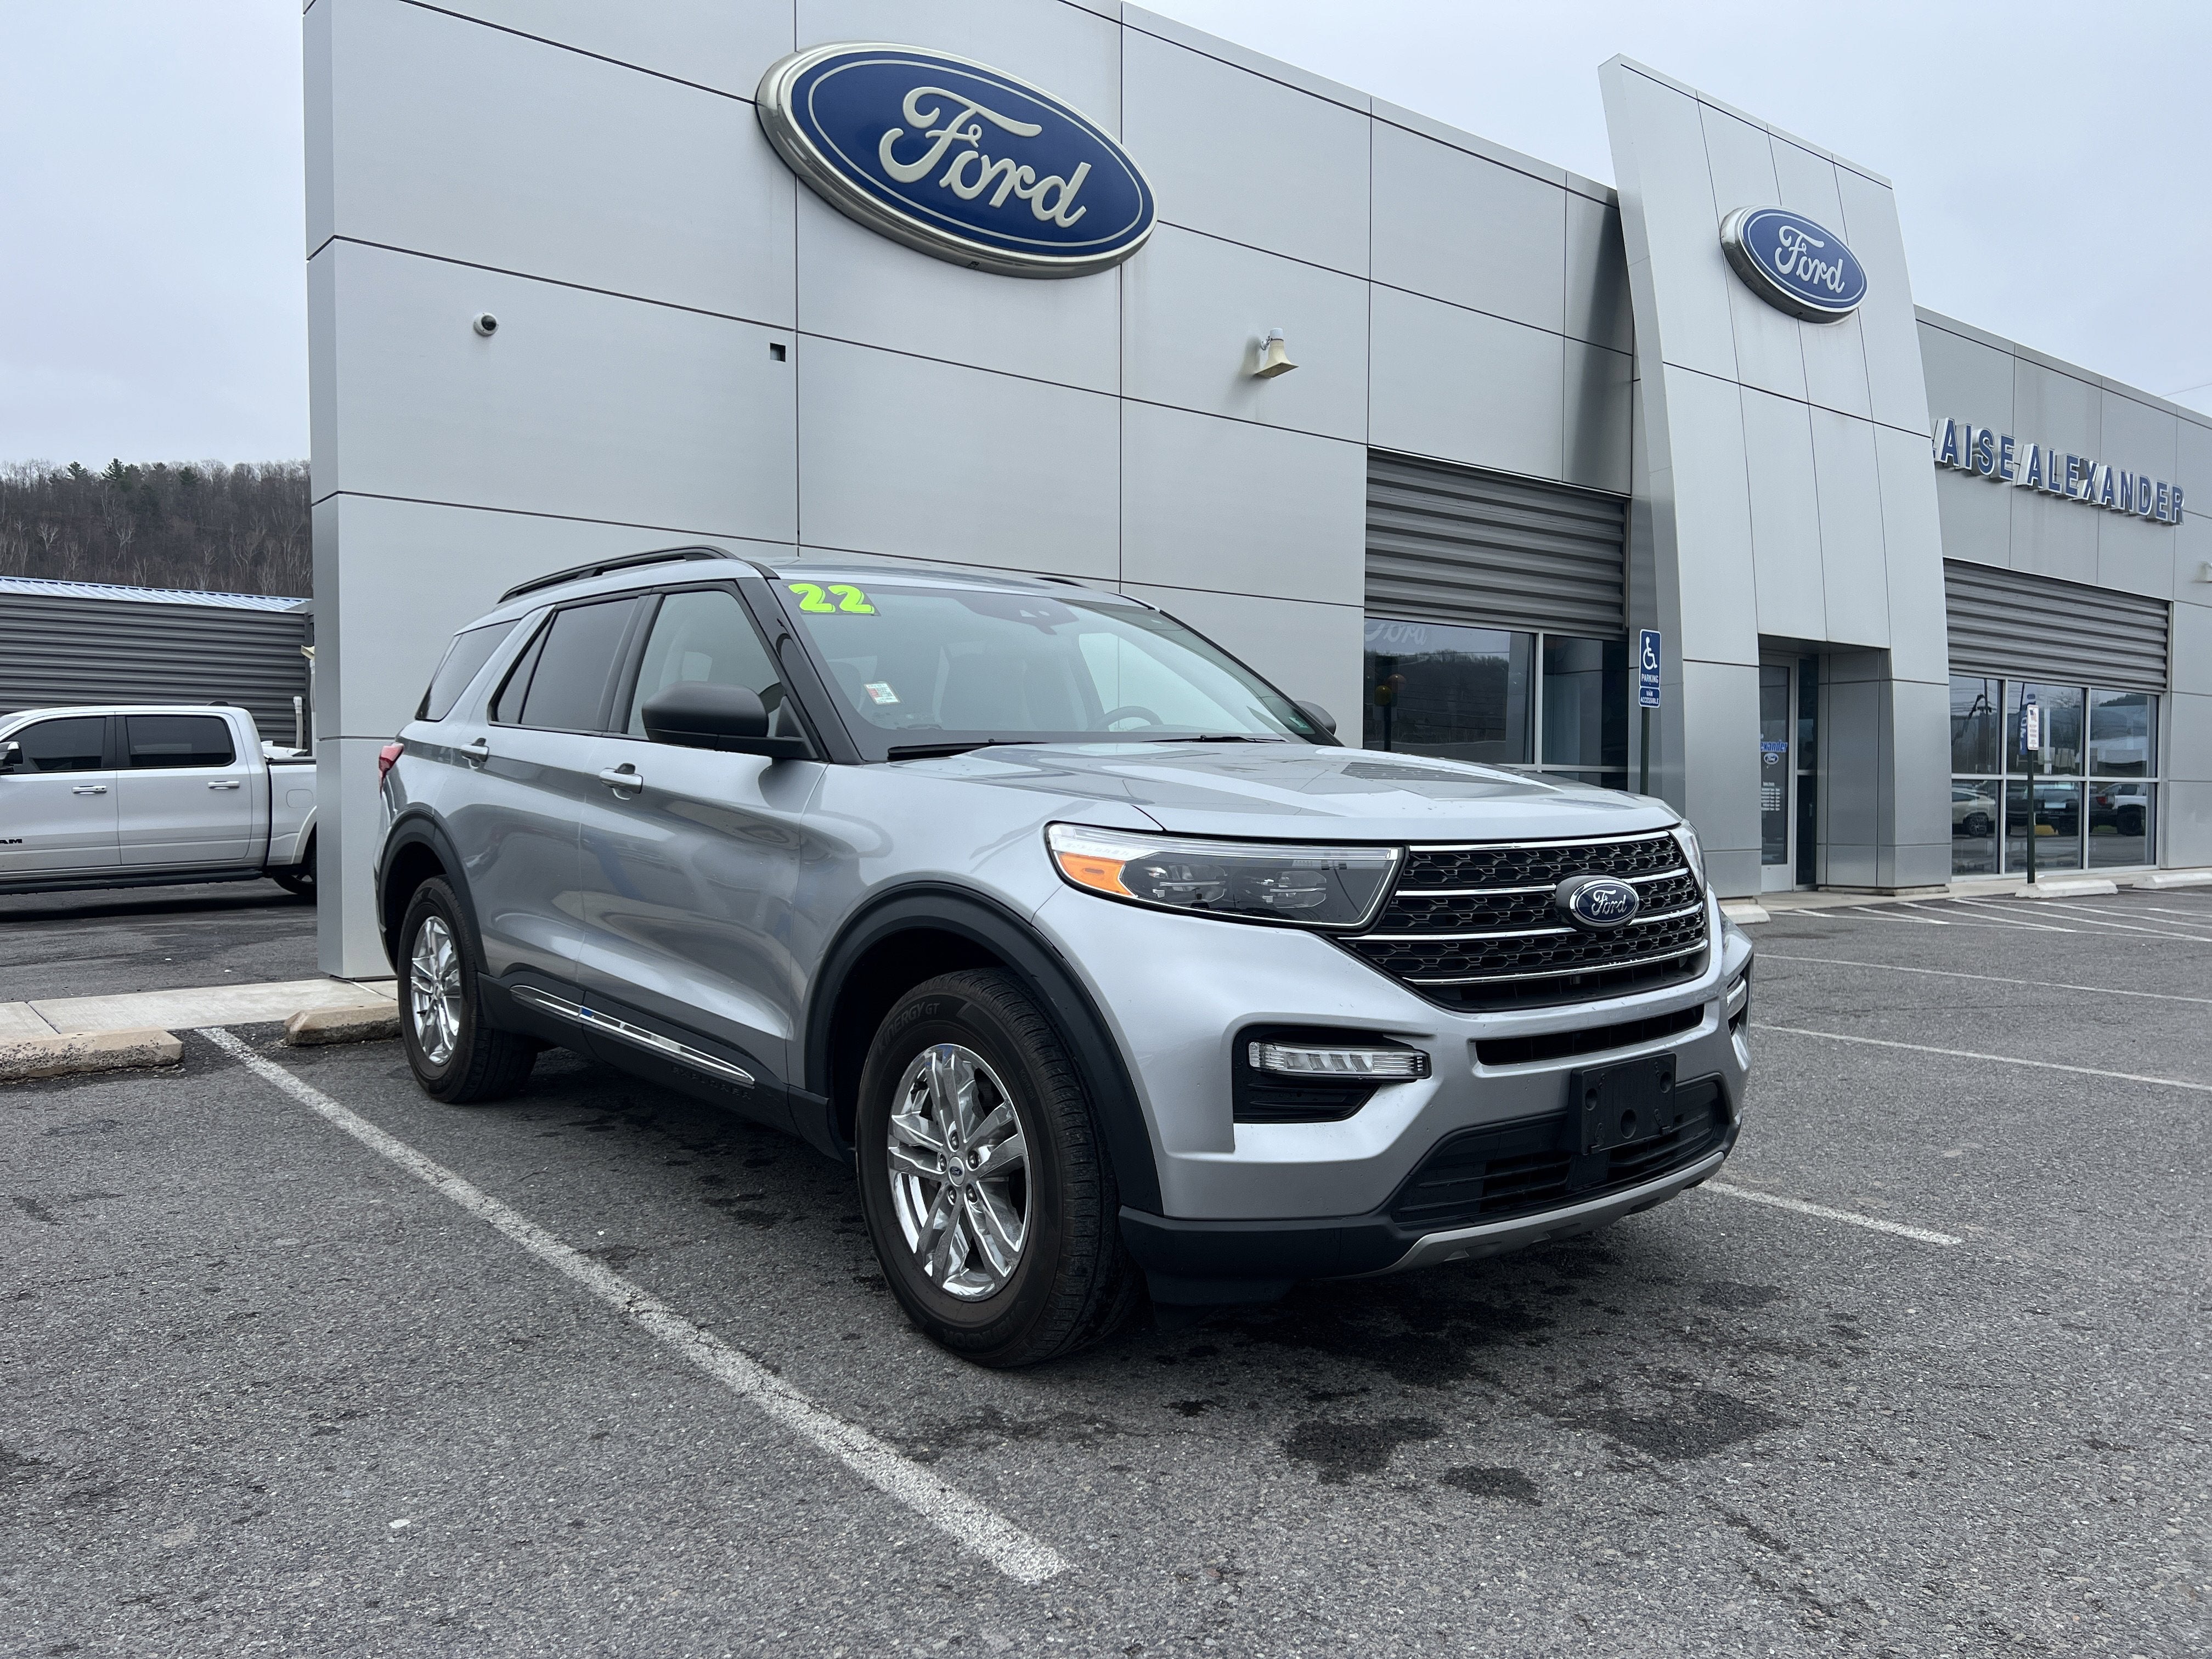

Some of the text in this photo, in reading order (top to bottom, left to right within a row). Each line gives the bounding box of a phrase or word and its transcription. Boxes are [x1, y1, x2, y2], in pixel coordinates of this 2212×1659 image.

[878, 86, 1091, 228] Ford
[1775, 225, 1845, 293] Ford
[1933, 417, 2185, 525] AISE ALEXANDER
[788, 583, 875, 614] 22
[1641, 673, 1659, 684] PARKING
[1760, 740, 1787, 752] exander
[1592, 889, 1628, 916] Ford
[926, 1003, 941, 1014] GT
